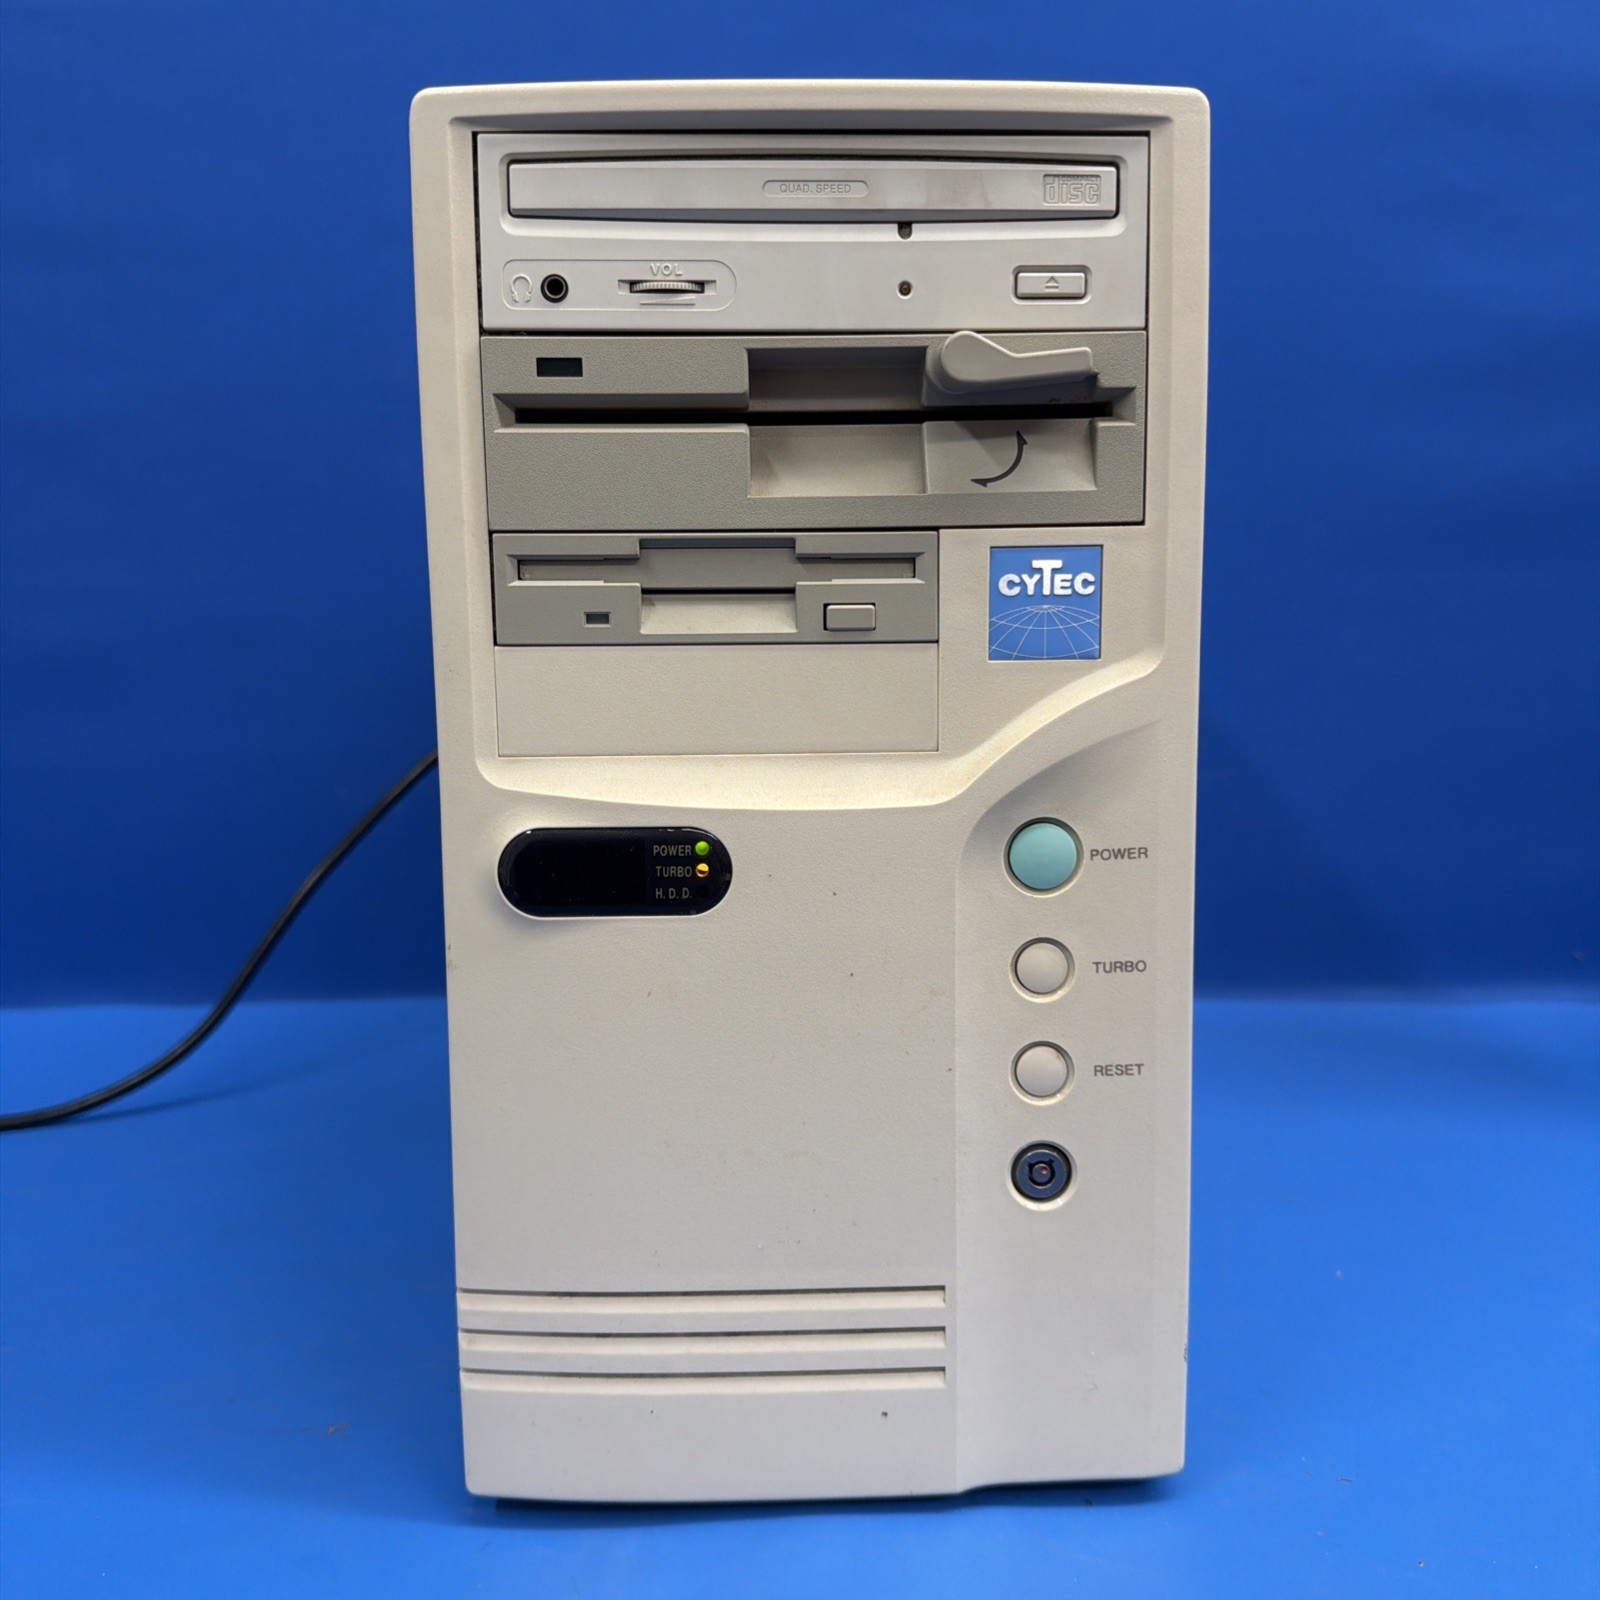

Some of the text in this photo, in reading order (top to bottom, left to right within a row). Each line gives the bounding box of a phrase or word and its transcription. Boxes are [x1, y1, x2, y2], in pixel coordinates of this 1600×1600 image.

[815, 183, 852, 194] SPEED
[650, 263, 683, 276] VOL
[998, 559, 1096, 597] CYTEC
[653, 844, 692, 857] POWER
[1089, 846, 1149, 862] POWER
[655, 865, 693, 878] TURBO
[1092, 959, 1148, 975] TURBO
[1093, 1062, 1145, 1078] RESET
